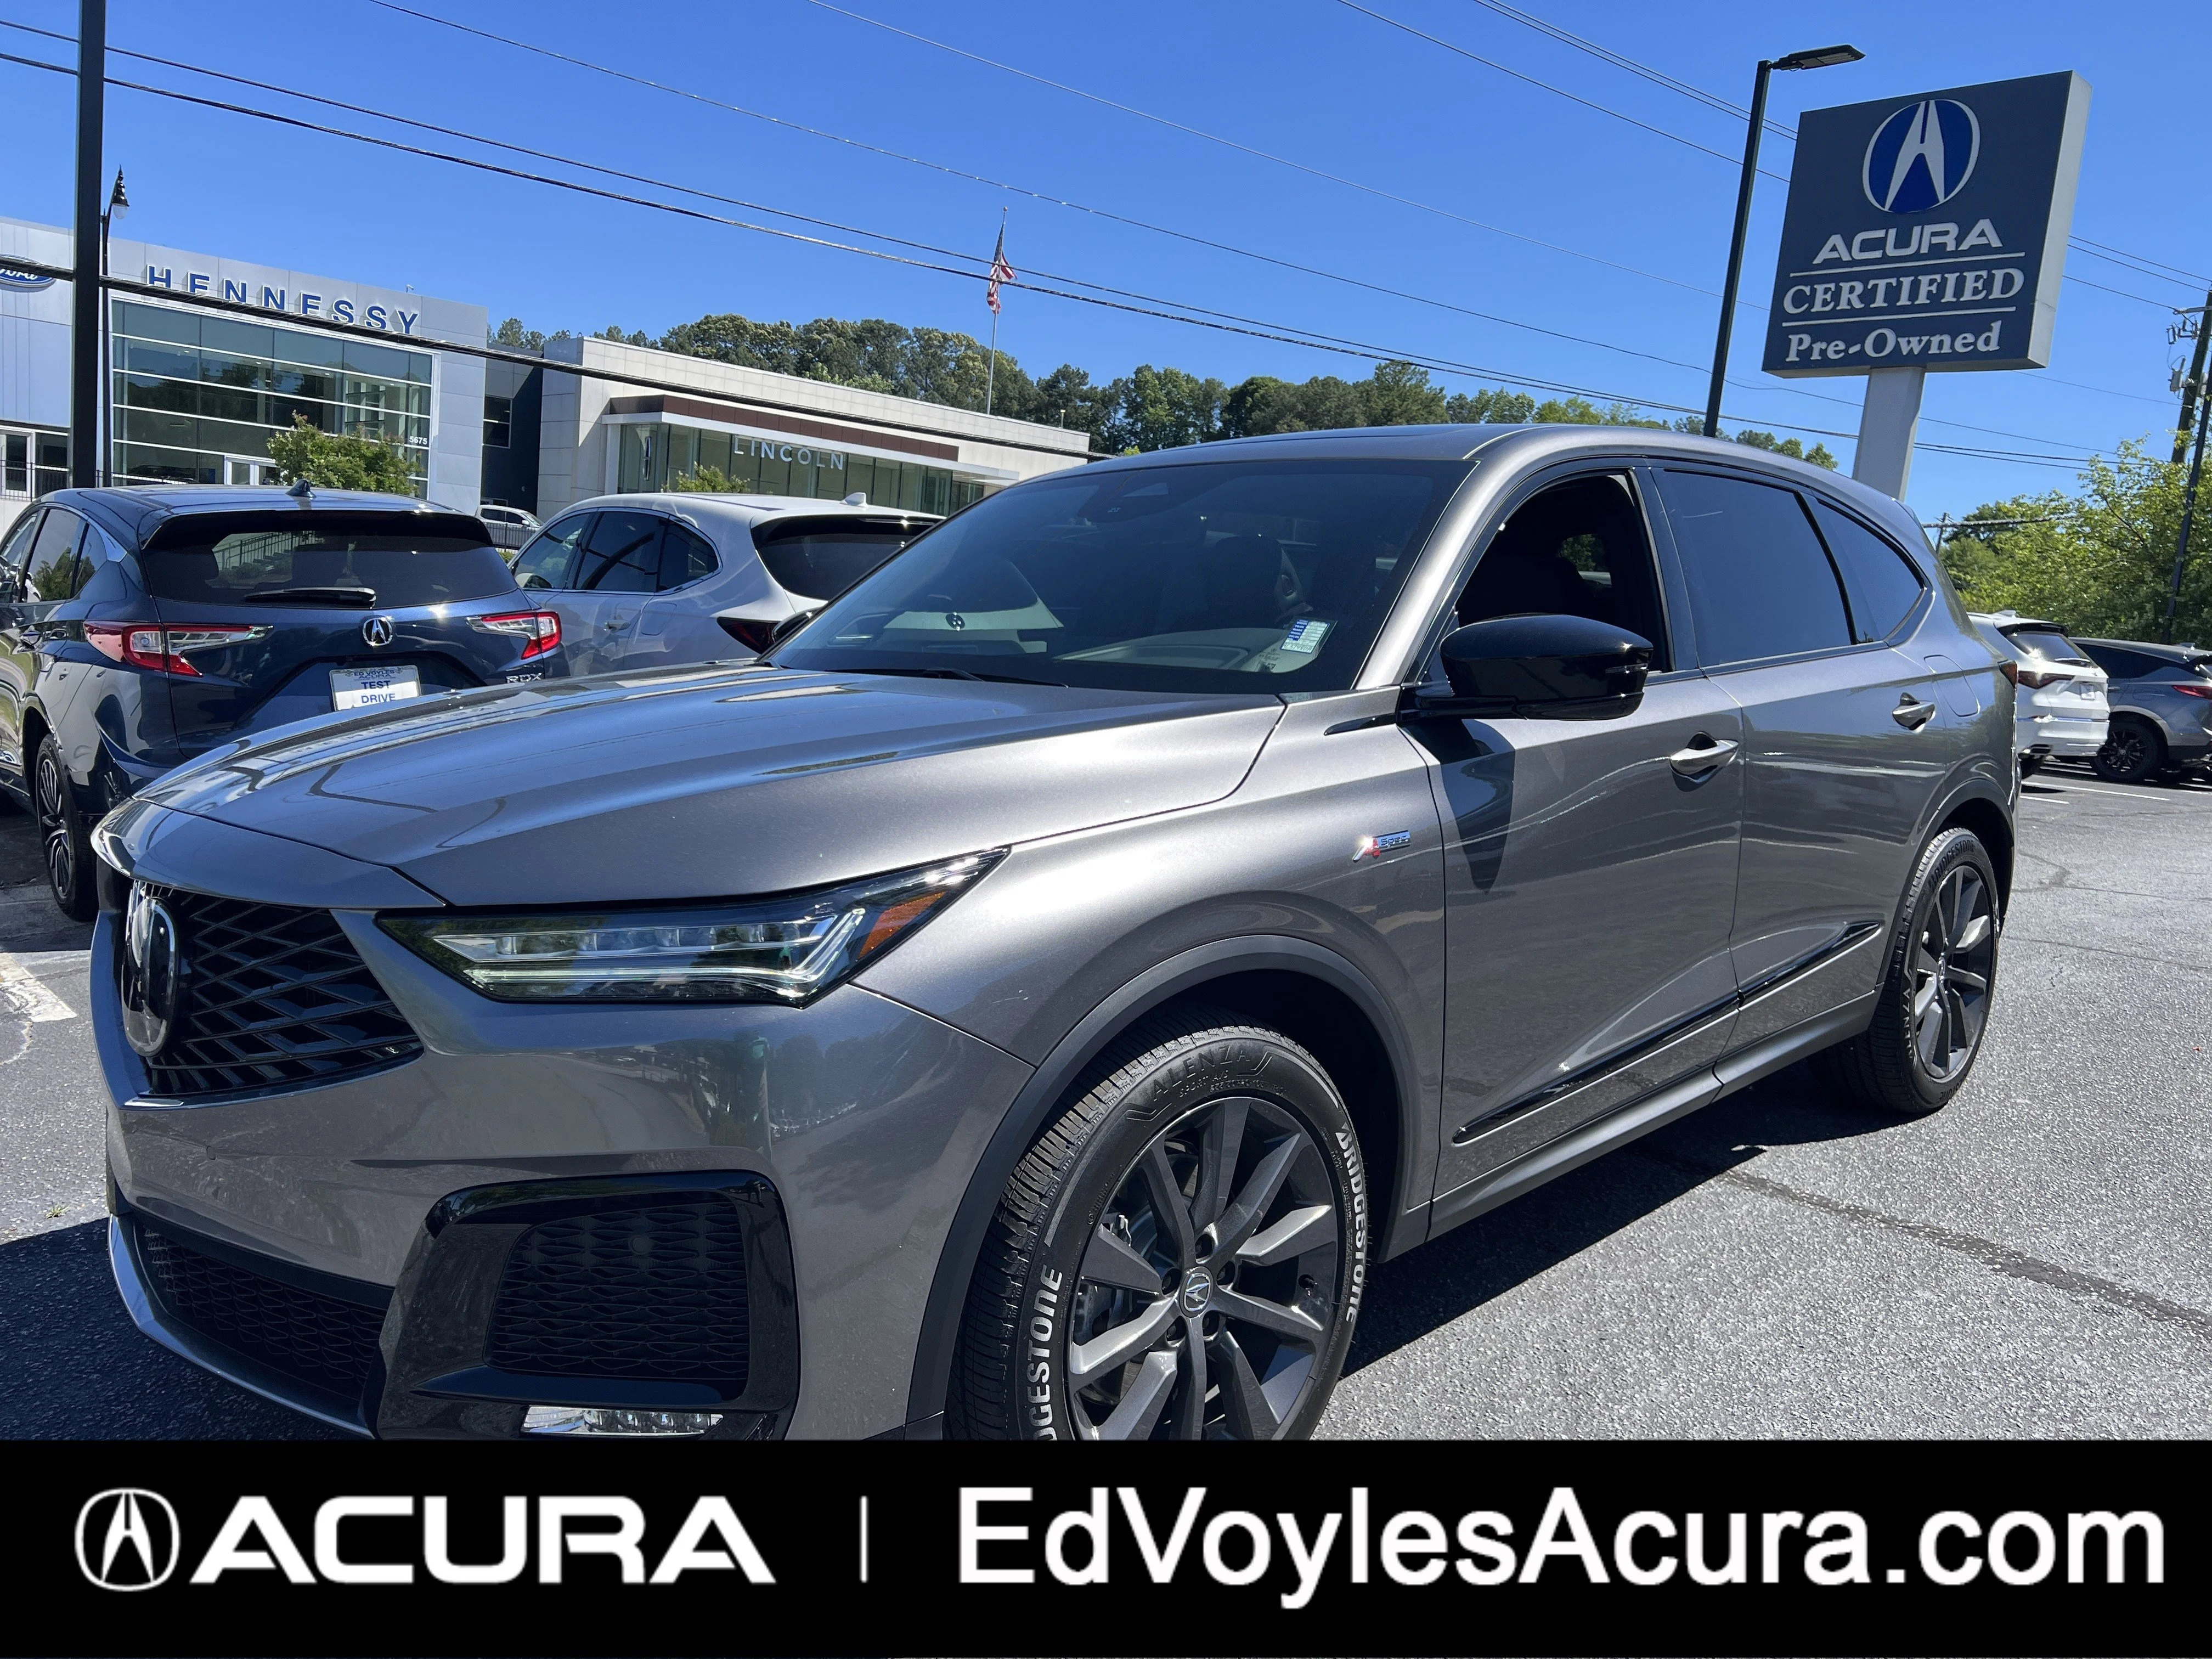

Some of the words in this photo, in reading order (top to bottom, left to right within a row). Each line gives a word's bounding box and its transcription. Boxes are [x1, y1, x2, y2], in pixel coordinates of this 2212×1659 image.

[1812, 218, 2003, 264] ACURA
[146, 264, 419, 334] HENNESSY
[1782, 267, 2025, 314] CERTIFIED
[1785, 320, 2002, 362] Pre-Owned
[409, 436, 428, 445] 5675
[734, 437, 844, 470] LINCOLN
[360, 680, 391, 690] TEST
[361, 693, 396, 704] DRIVE
[506, 673, 542, 684] RDX
[1153, 1045, 1250, 1102] ALENZA
[1335, 1122, 1366, 1323] BRIDGESTONE
